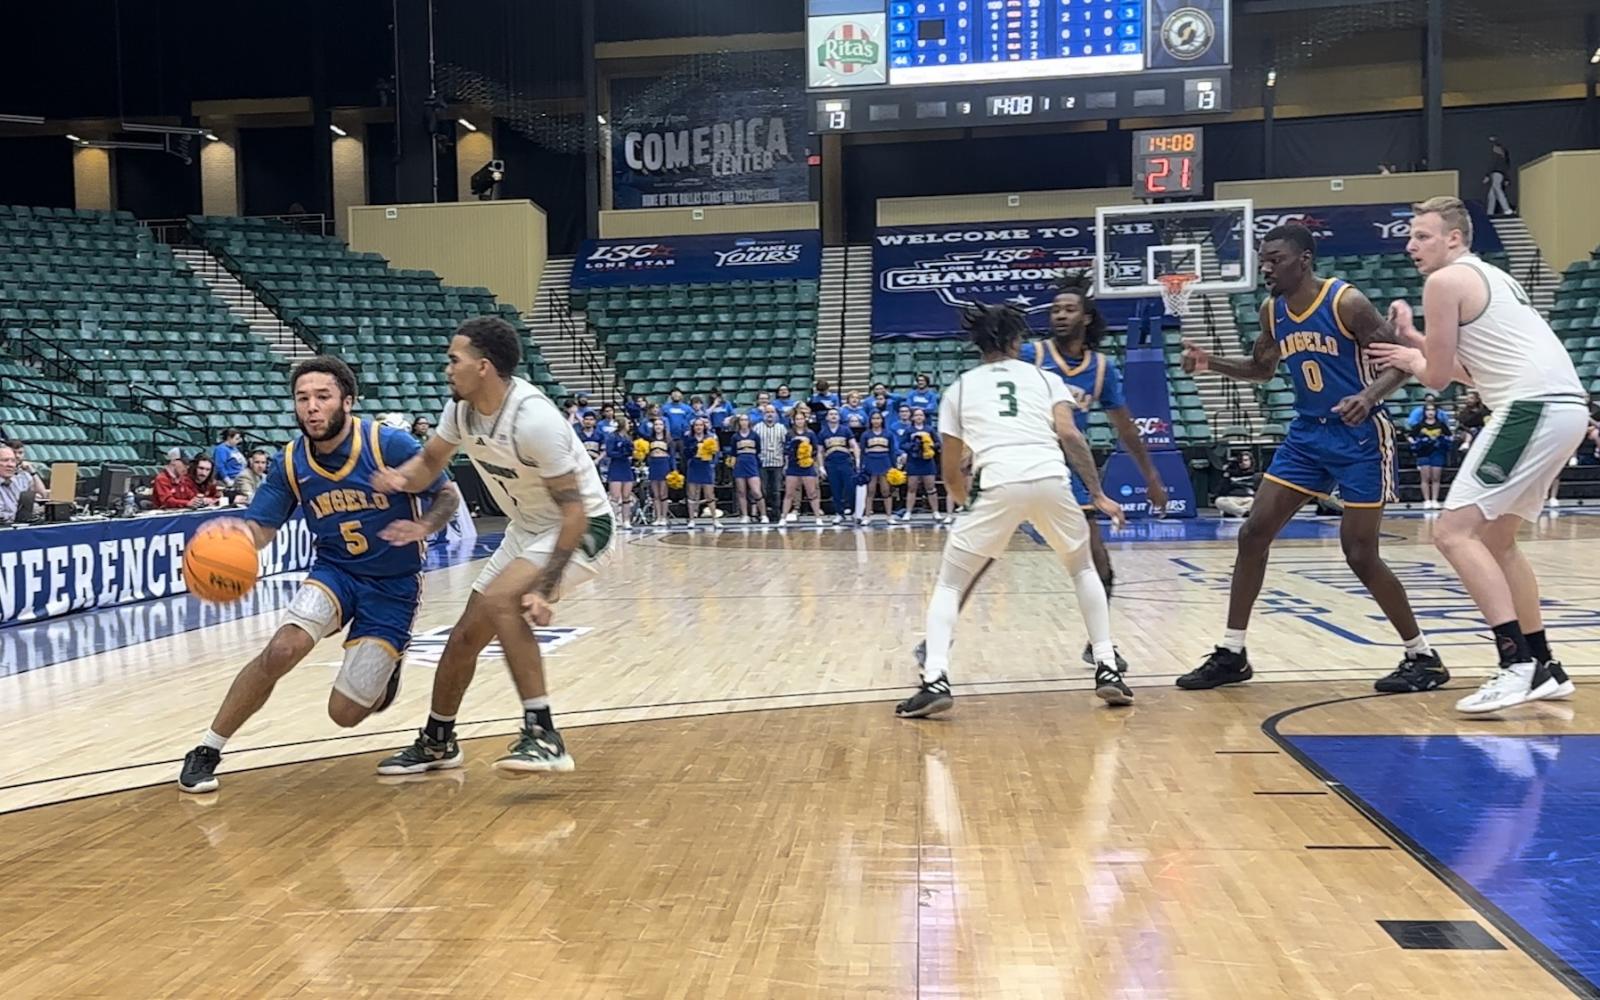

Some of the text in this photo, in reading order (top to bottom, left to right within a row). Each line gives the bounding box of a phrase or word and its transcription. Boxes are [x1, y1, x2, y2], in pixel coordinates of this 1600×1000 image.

[897, 5, 905, 15] 3
[916, 3, 926, 14] 0
[938, 2, 945, 12] 1
[1061, 12, 1070, 22] 2
[1083, 10, 1091, 20] 1
[1125, 8, 1134, 18] 3
[1061, 29, 1071, 39] 0
[1083, 27, 1091, 37] 1
[962, 96, 1075, 115] 3 14:08 1 2
[624, 117, 789, 171] COMERICA
[1148, 133, 1195, 151] 14:08
[711, 150, 774, 177] CENTER
[1146, 158, 1192, 192] 21
[877, 228, 1031, 246] WELCOME
[1038, 227, 1079, 240] TO
[587, 244, 658, 262] LSC
[714, 248, 800, 267] YOURS
[982, 249, 1034, 263] LSC
[585, 261, 626, 269] LONE
[634, 259, 675, 267] STAR
[1301, 359, 1324, 393] 0
[996, 381, 1018, 417] 3
[339, 519, 369, 556] 5
